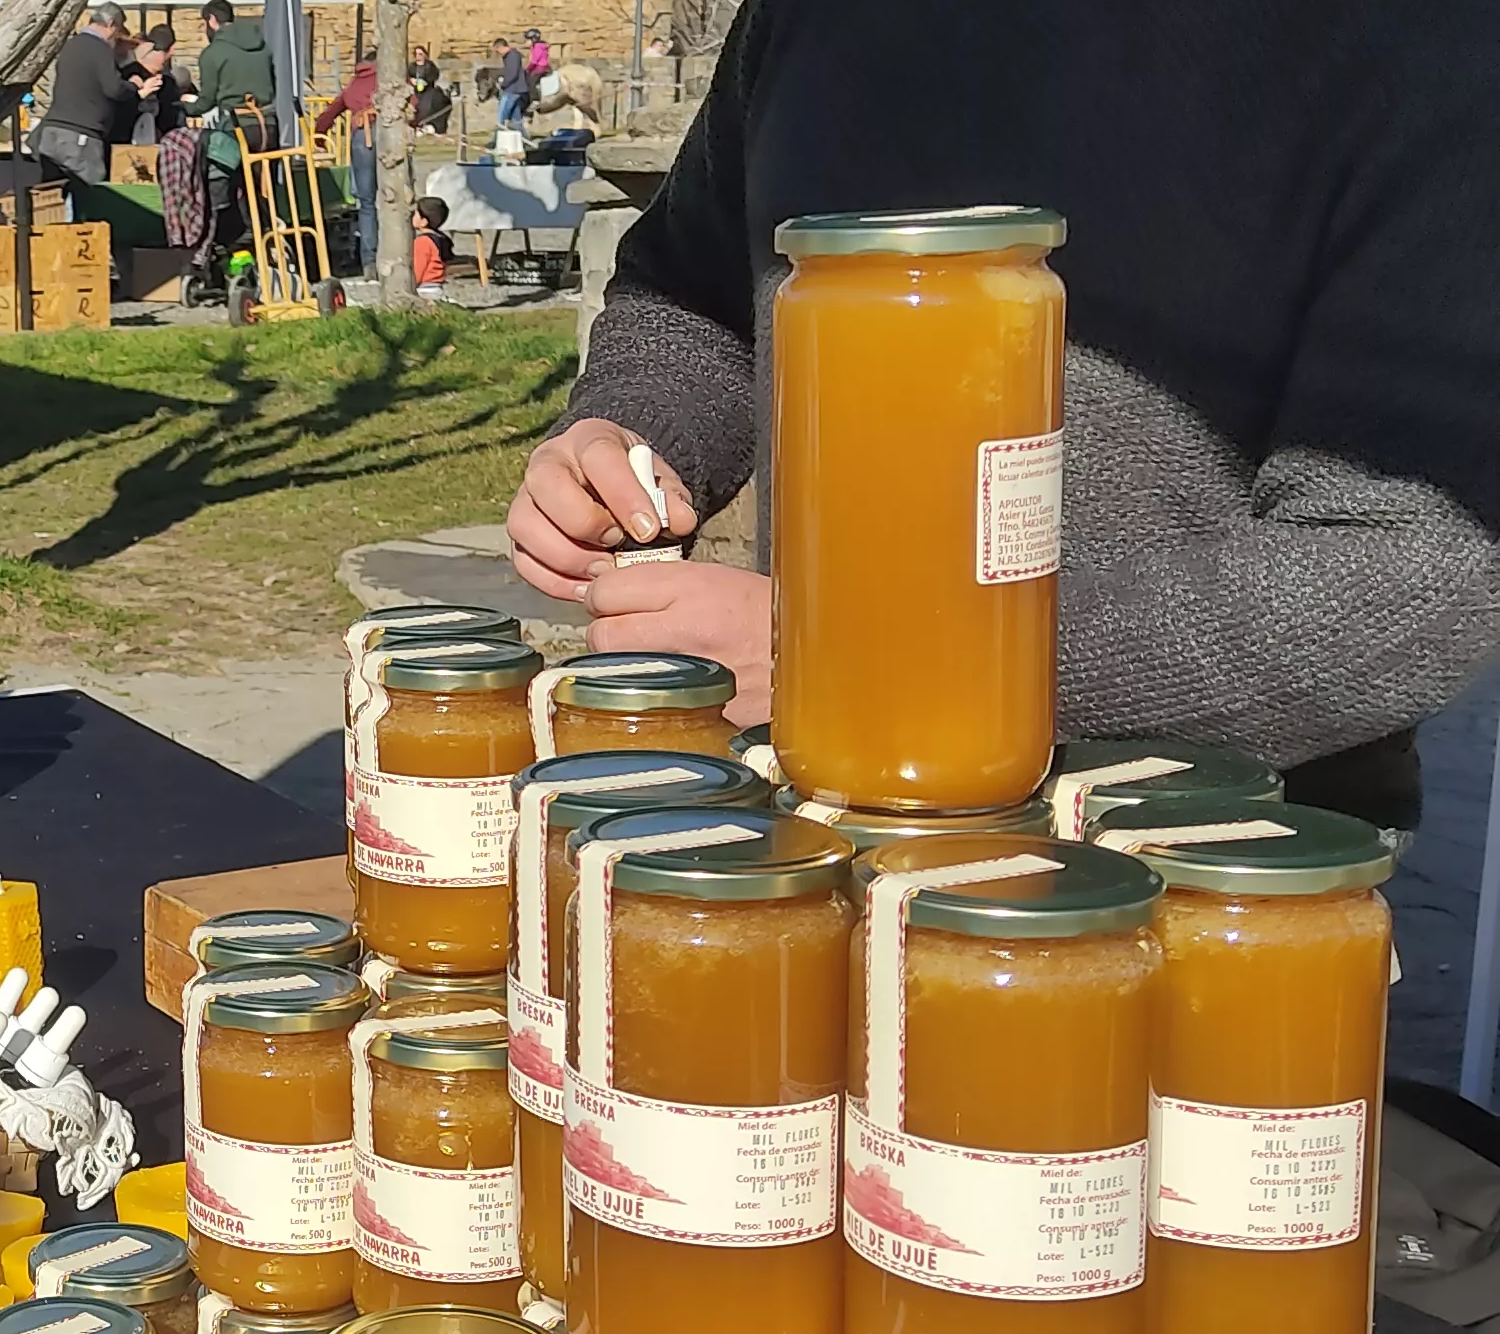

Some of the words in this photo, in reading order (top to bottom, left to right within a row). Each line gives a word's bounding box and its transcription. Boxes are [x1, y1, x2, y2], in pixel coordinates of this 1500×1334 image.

[999, 461, 1007, 469] La
[999, 495, 1042, 509] APICULTOR
[999, 544, 1023, 555] 31191
[358, 844, 365, 858] DE
[368, 848, 425, 874] NAVARRA
[490, 862, 505, 872] 500
[517, 997, 554, 1028] BRESKA
[525, 1080, 538, 1099] DE
[574, 1088, 616, 1122] BRESKA
[762, 1122, 777, 1130] de:
[1252, 1124, 1276, 1132] Miel
[1279, 1124, 1296, 1132] de:
[753, 1134, 774, 1145] MIL
[786, 1127, 820, 1143] FLORES
[1265, 1139, 1288, 1151] MIL
[1301, 1135, 1341, 1150] FLORES
[737, 1147, 766, 1156] Fecha
[769, 1147, 780, 1155] de
[859, 1131, 906, 1168] BRESKA
[1251, 1150, 1282, 1158] Fecha
[1285, 1150, 1298, 1158] de
[298, 1165, 315, 1176] MIL
[1041, 1169, 1064, 1178] Miel
[1067, 1169, 1083, 1177] de:
[1289, 1162, 1300, 1174] 10
[1050, 1182, 1072, 1194] MIL
[1086, 1175, 1124, 1192] FLORES
[1250, 1177, 1300, 1185] Consumir
[1303, 1176, 1328, 1184] antes
[1330, 1173, 1343, 1181] de:
[1287, 1186, 1300, 1197] 10
[478, 1193, 496, 1203] MIL
[583, 1183, 598, 1203] DE
[603, 1190, 644, 1219] UJUÉ
[1040, 1196, 1070, 1205] Fecha
[1073, 1195, 1086, 1204] de
[735, 1201, 761, 1209] Lote:
[1073, 1205, 1084, 1217] 10
[1249, 1203, 1276, 1212] Lote:
[1296, 1200, 1330, 1214] L-523
[193, 1202, 245, 1235] NAVARRA
[735, 1222, 761, 1230] Peso:
[768, 1217, 795, 1229] 1000
[798, 1218, 804, 1228] g
[1038, 1223, 1089, 1233] Consumir
[1248, 1224, 1276, 1233] Peso:
[1284, 1222, 1313, 1233] 1000
[1317, 1223, 1323, 1234] g
[309, 1230, 325, 1240] 500
[326, 1230, 332, 1240] g
[364, 1233, 421, 1266] NAVARRA
[868, 1232, 885, 1253] DE
[892, 1239, 938, 1270] UJUÉ
[1038, 1252, 1064, 1261] Lote:
[1081, 1244, 1114, 1259] L-523
[488, 1256, 505, 1268] 500
[506, 1257, 512, 1267] g
[1036, 1274, 1065, 1282] Peso:
[1072, 1269, 1101, 1281] 1000
[1104, 1269, 1111, 1280] g
